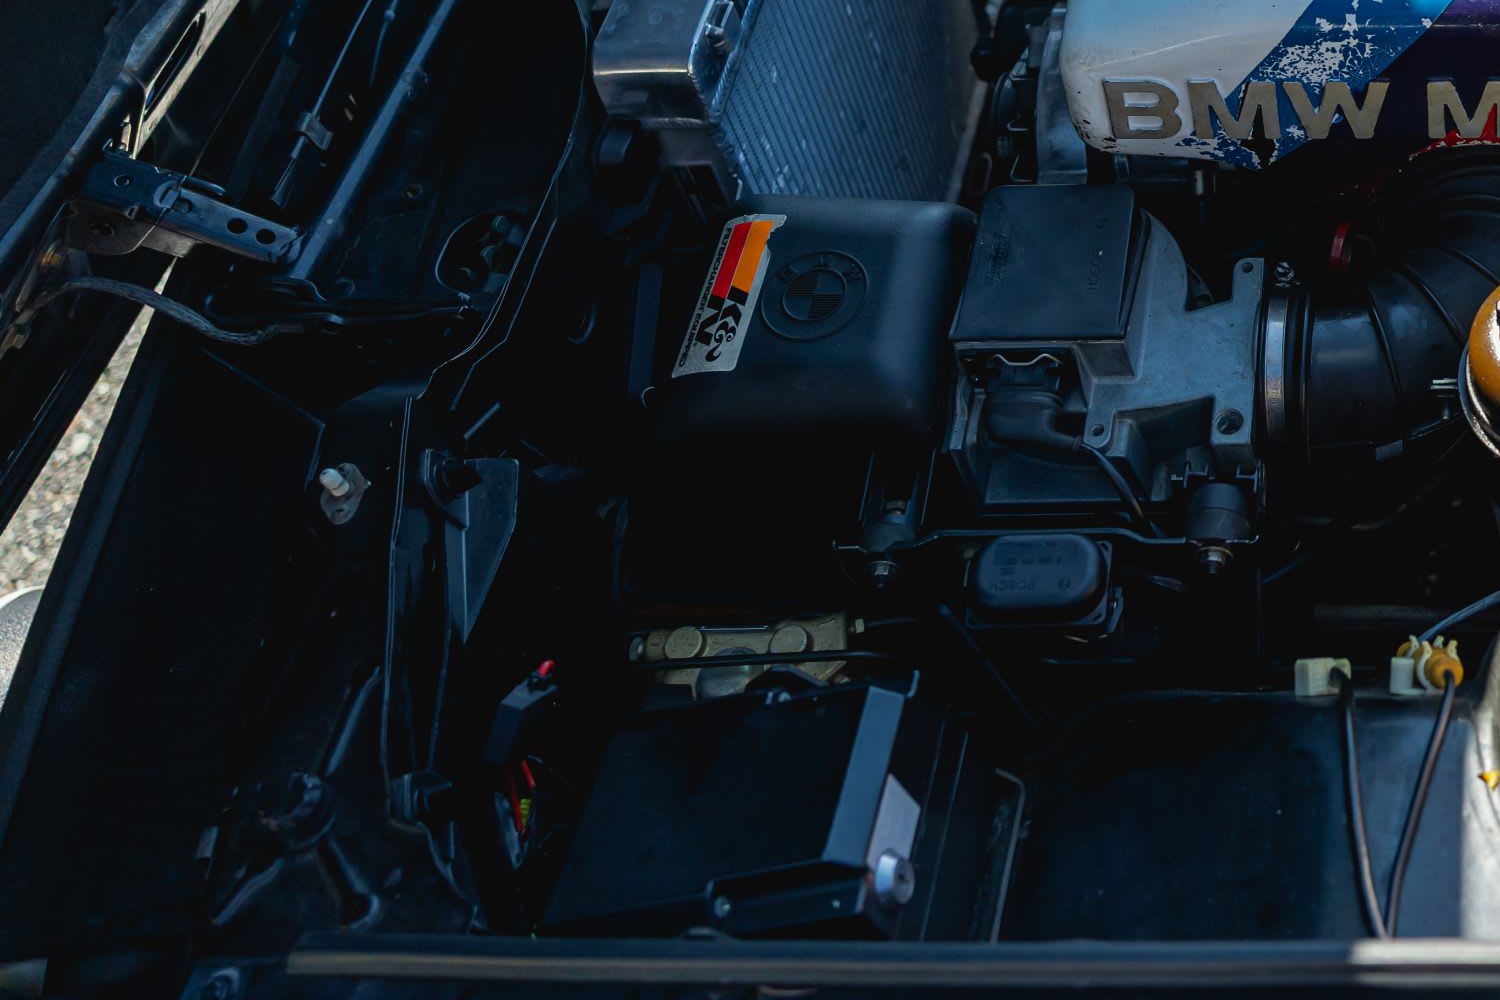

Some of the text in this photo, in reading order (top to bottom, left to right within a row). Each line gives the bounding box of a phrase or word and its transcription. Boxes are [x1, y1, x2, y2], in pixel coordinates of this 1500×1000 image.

[1103, 78, 1390, 140] BMW
[699, 227, 733, 311] FILTERCHARGER
[694, 285, 750, 363] K&N
